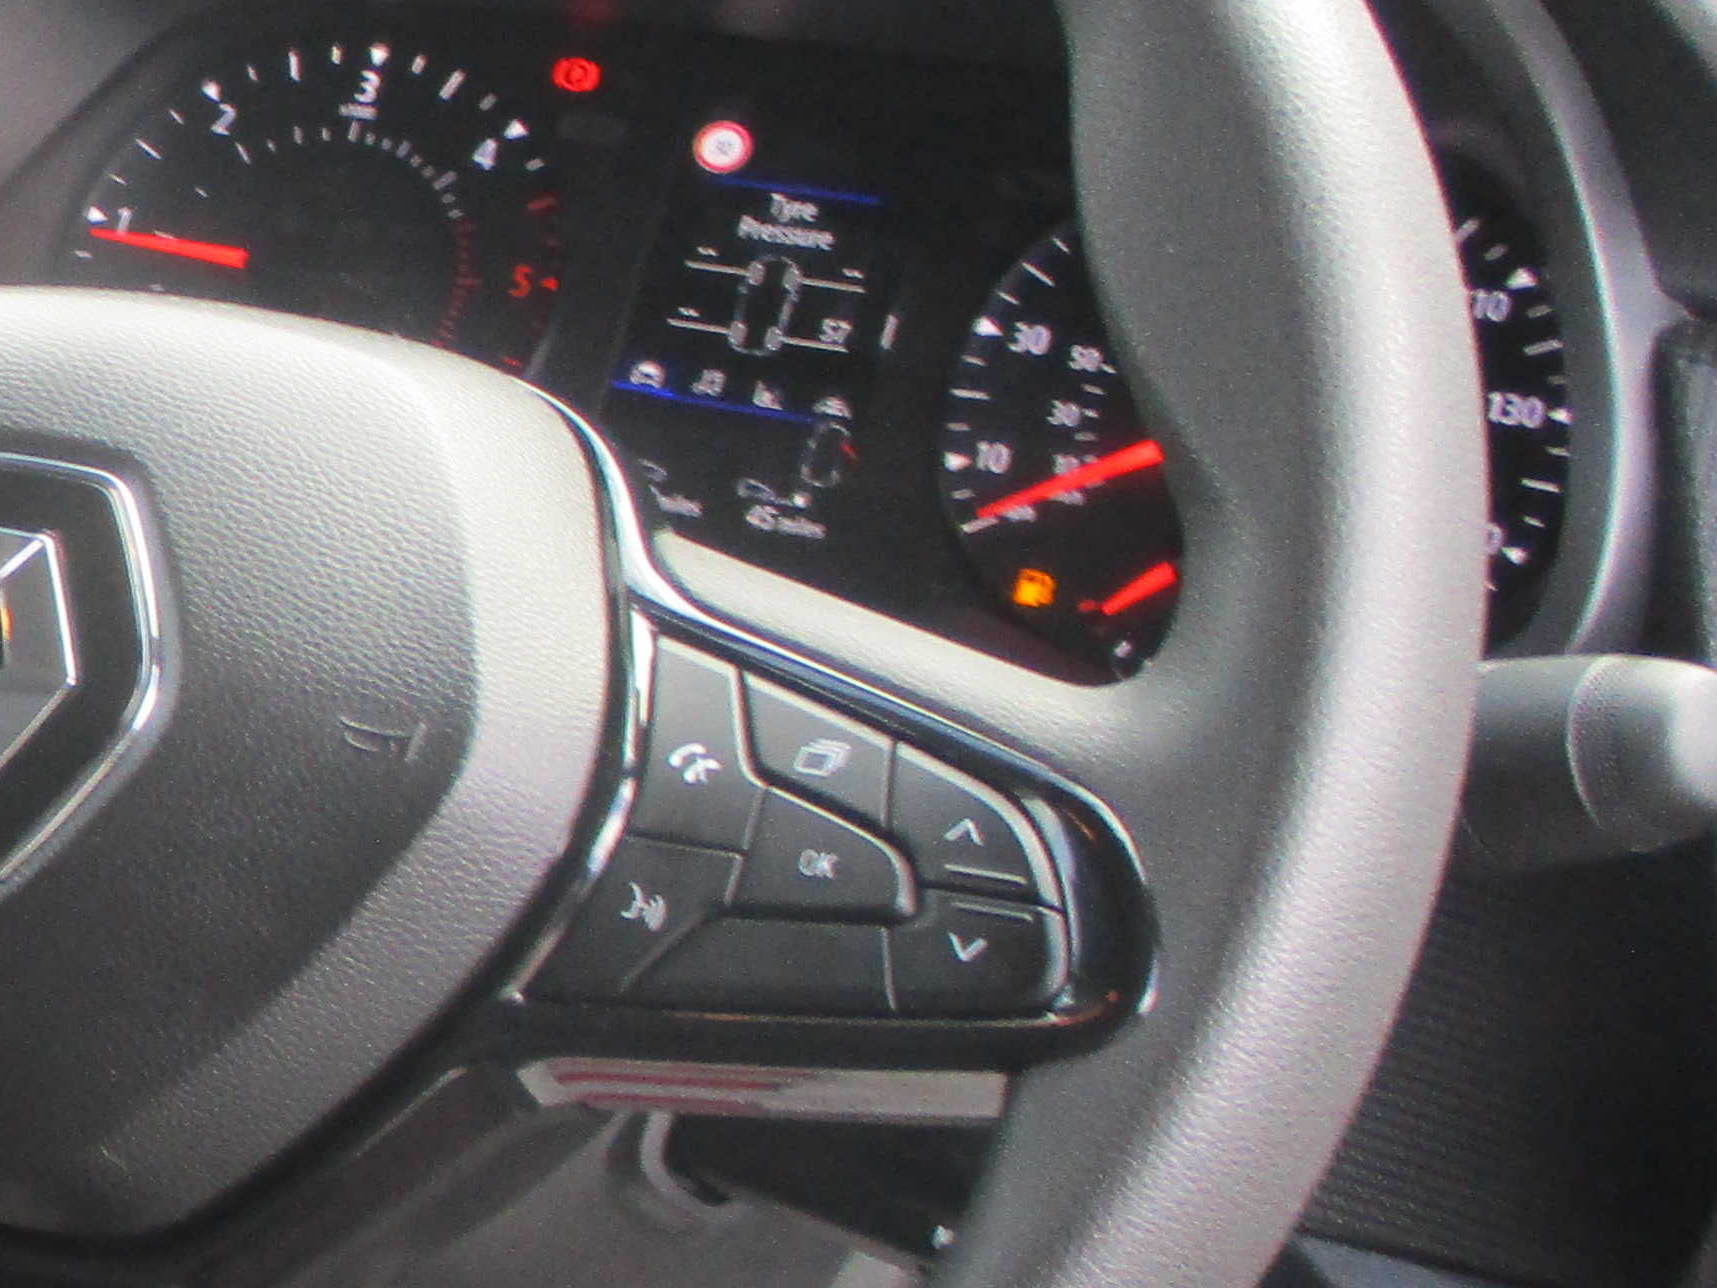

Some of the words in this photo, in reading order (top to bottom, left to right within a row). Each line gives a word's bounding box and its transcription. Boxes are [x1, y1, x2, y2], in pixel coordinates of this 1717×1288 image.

[355, 68, 382, 103] 3
[472, 137, 499, 171] 4
[770, 193, 819, 223] Tyre
[736, 214, 836, 251] Pressure
[507, 264, 534, 300] 5
[1472, 288, 1510, 323] 10
[1007, 320, 1053, 357] 30
[1068, 343, 1105, 374] 50
[1046, 398, 1084, 428] 30
[1487, 390, 1547, 429] 130
[975, 439, 1014, 476] 10
[798, 848, 842, 880] OK
